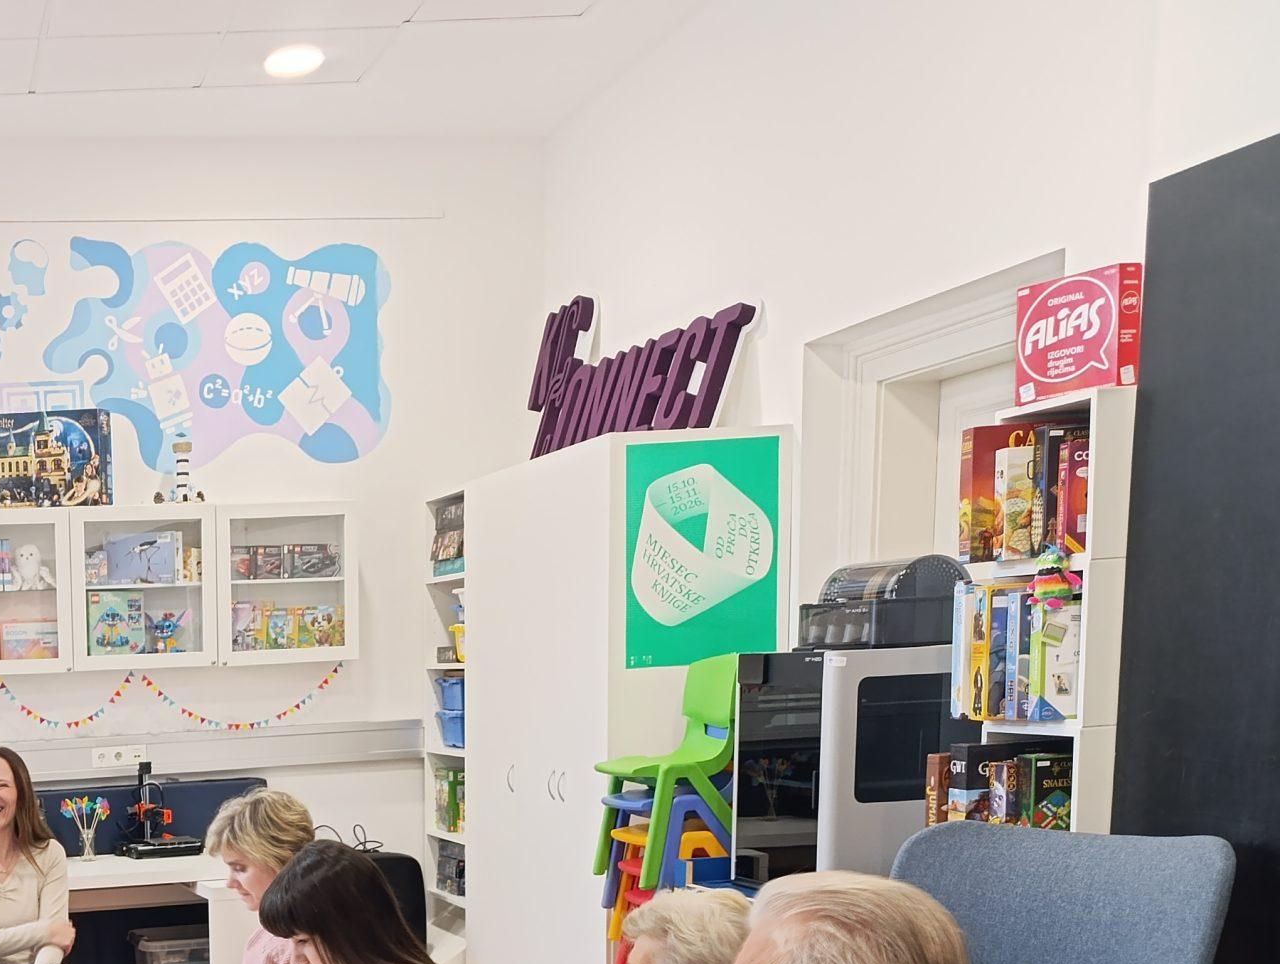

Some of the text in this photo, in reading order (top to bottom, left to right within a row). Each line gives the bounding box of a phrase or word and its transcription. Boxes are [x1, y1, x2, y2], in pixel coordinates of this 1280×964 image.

[1048, 292, 1085, 307] ORIGINAL
[1047, 345, 1084, 360] IZGOVORI
[1047, 357, 1074, 369] drugim
[739, 516, 748, 538] DO
[647, 533, 699, 584] MJESEC
[715, 536, 725, 559] OD
[642, 548, 706, 605] HRVATSKE
[651, 579, 692, 613] KNJIGE
[950, 760, 967, 775] GWT
[925, 786, 937, 827] JUMA
